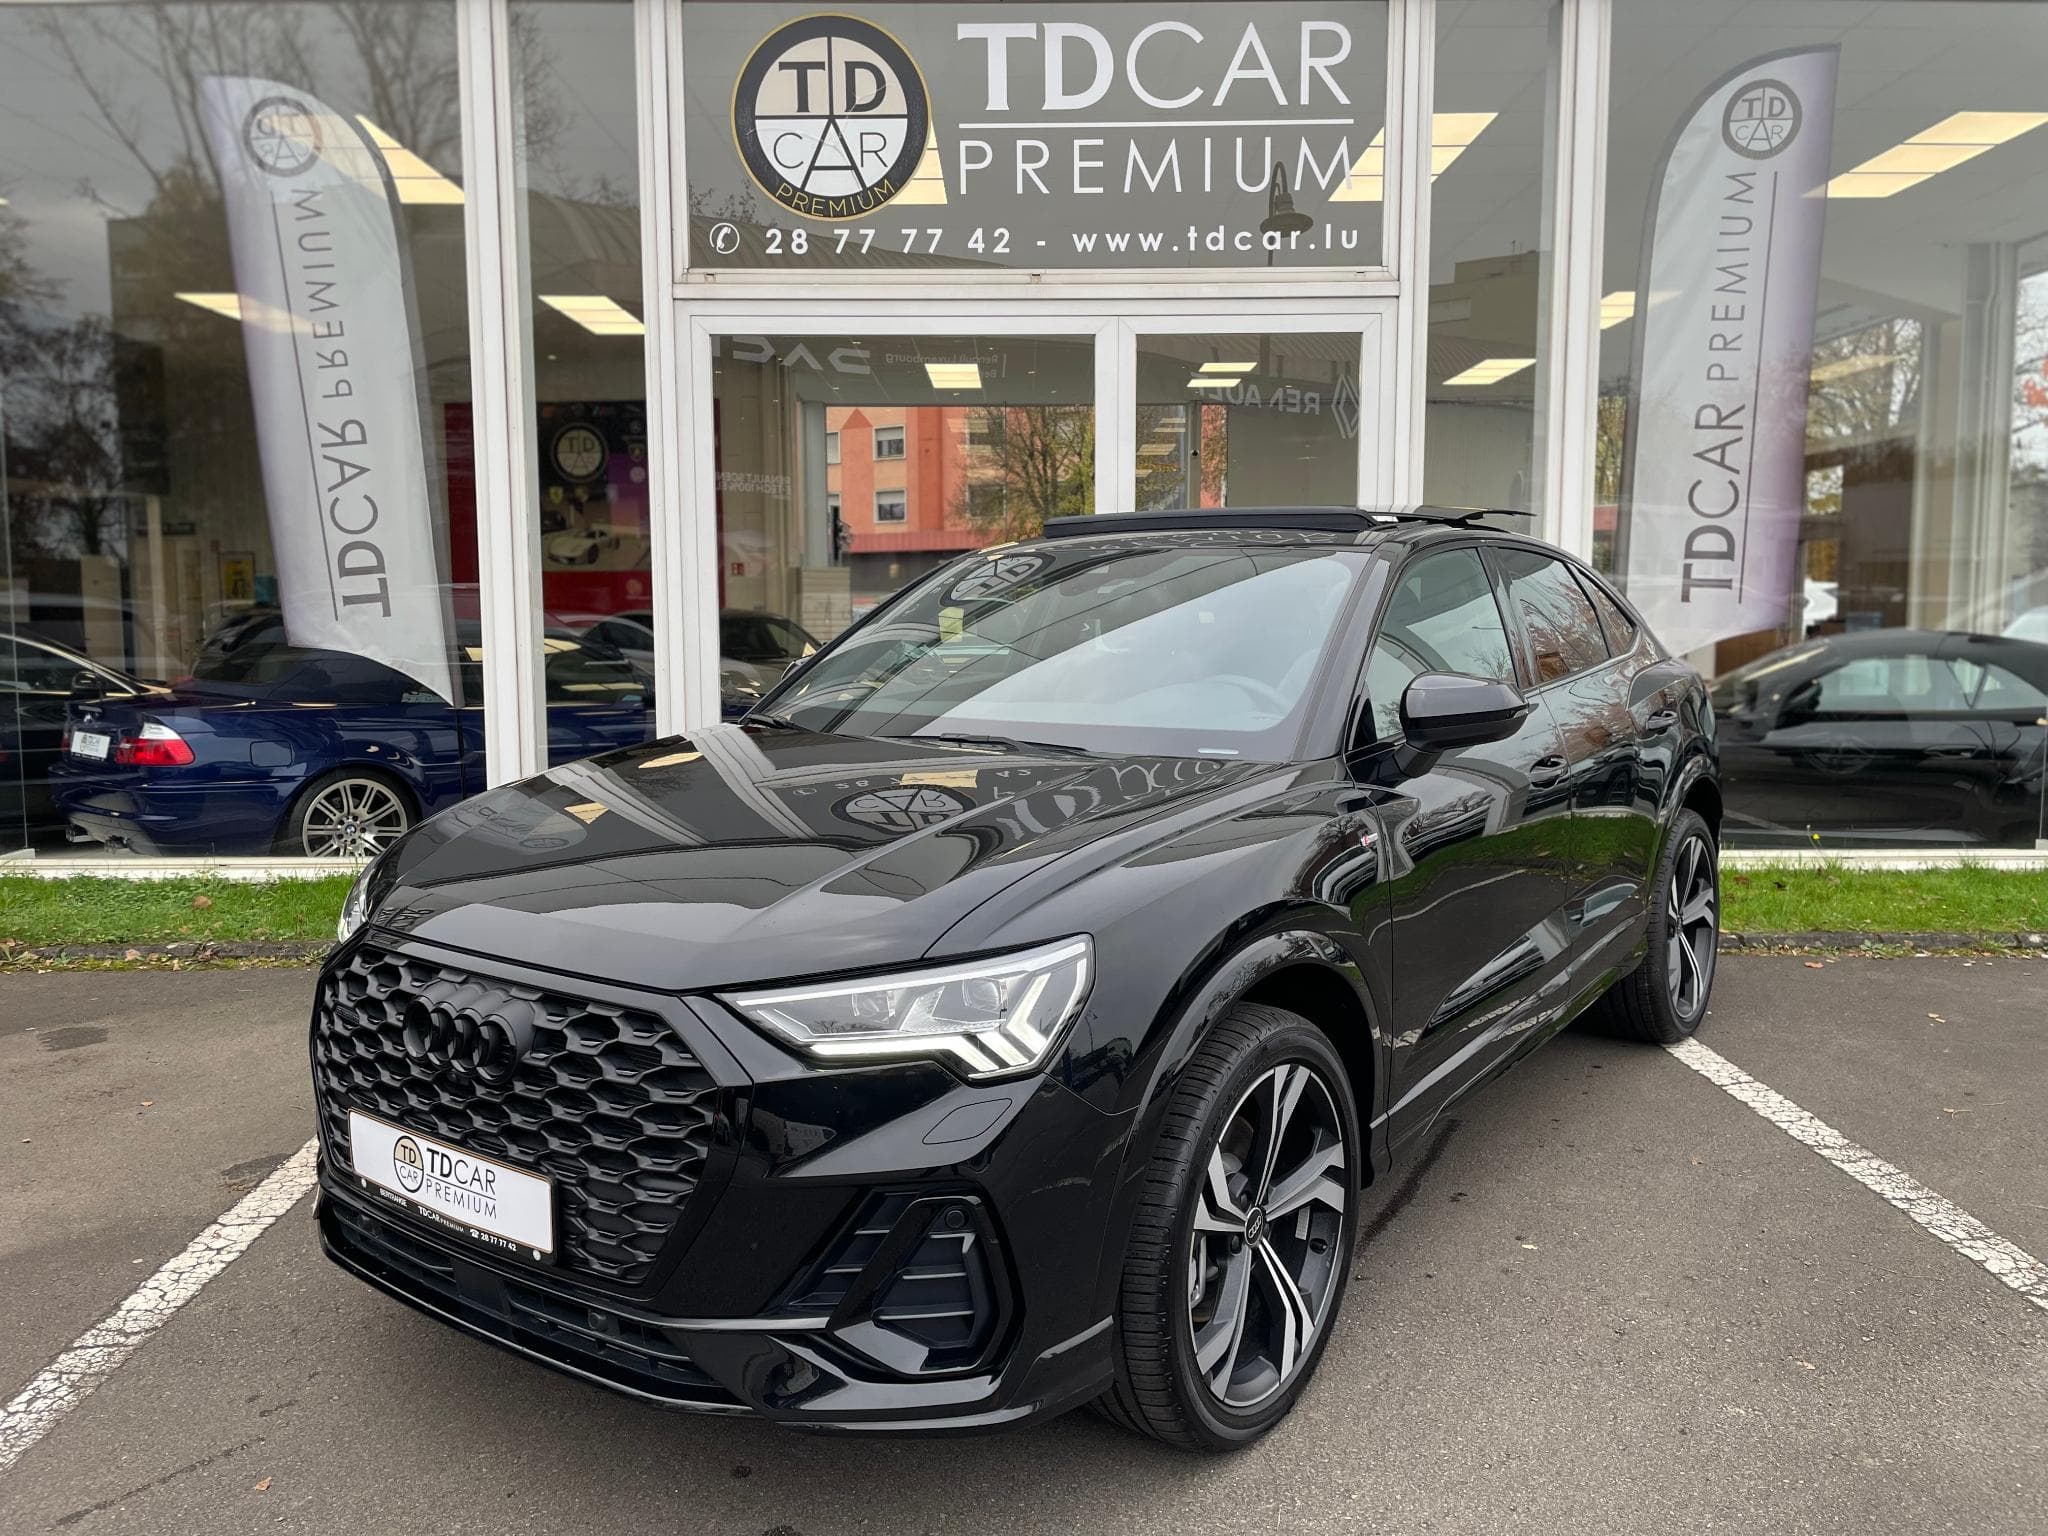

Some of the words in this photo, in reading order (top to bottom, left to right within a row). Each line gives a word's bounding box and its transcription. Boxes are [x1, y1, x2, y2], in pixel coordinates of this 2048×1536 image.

[778, 60, 887, 113] TD
[957, 20, 1353, 112] TDCAR
[1741, 96, 1787, 118] TD
[773, 118, 889, 191] CAR
[1735, 119, 1785, 149] CAR
[958, 135, 1354, 195] PREMIUM
[775, 179, 896, 217] PREMIUM
[765, 228, 809, 254] 28
[833, 228, 876, 254] 77
[901, 228, 943, 254] 77
[967, 227, 1010, 254] 42
[1072, 223, 1358, 253] www.tdcar.lu
[1706, 171, 1757, 381] PREMIUM
[1681, 403, 1746, 603] TDCAR
[401, 1144, 416, 1164] TD
[426, 1147, 496, 1195] TDCAR
[426, 1178, 496, 1219] PREMIUM
